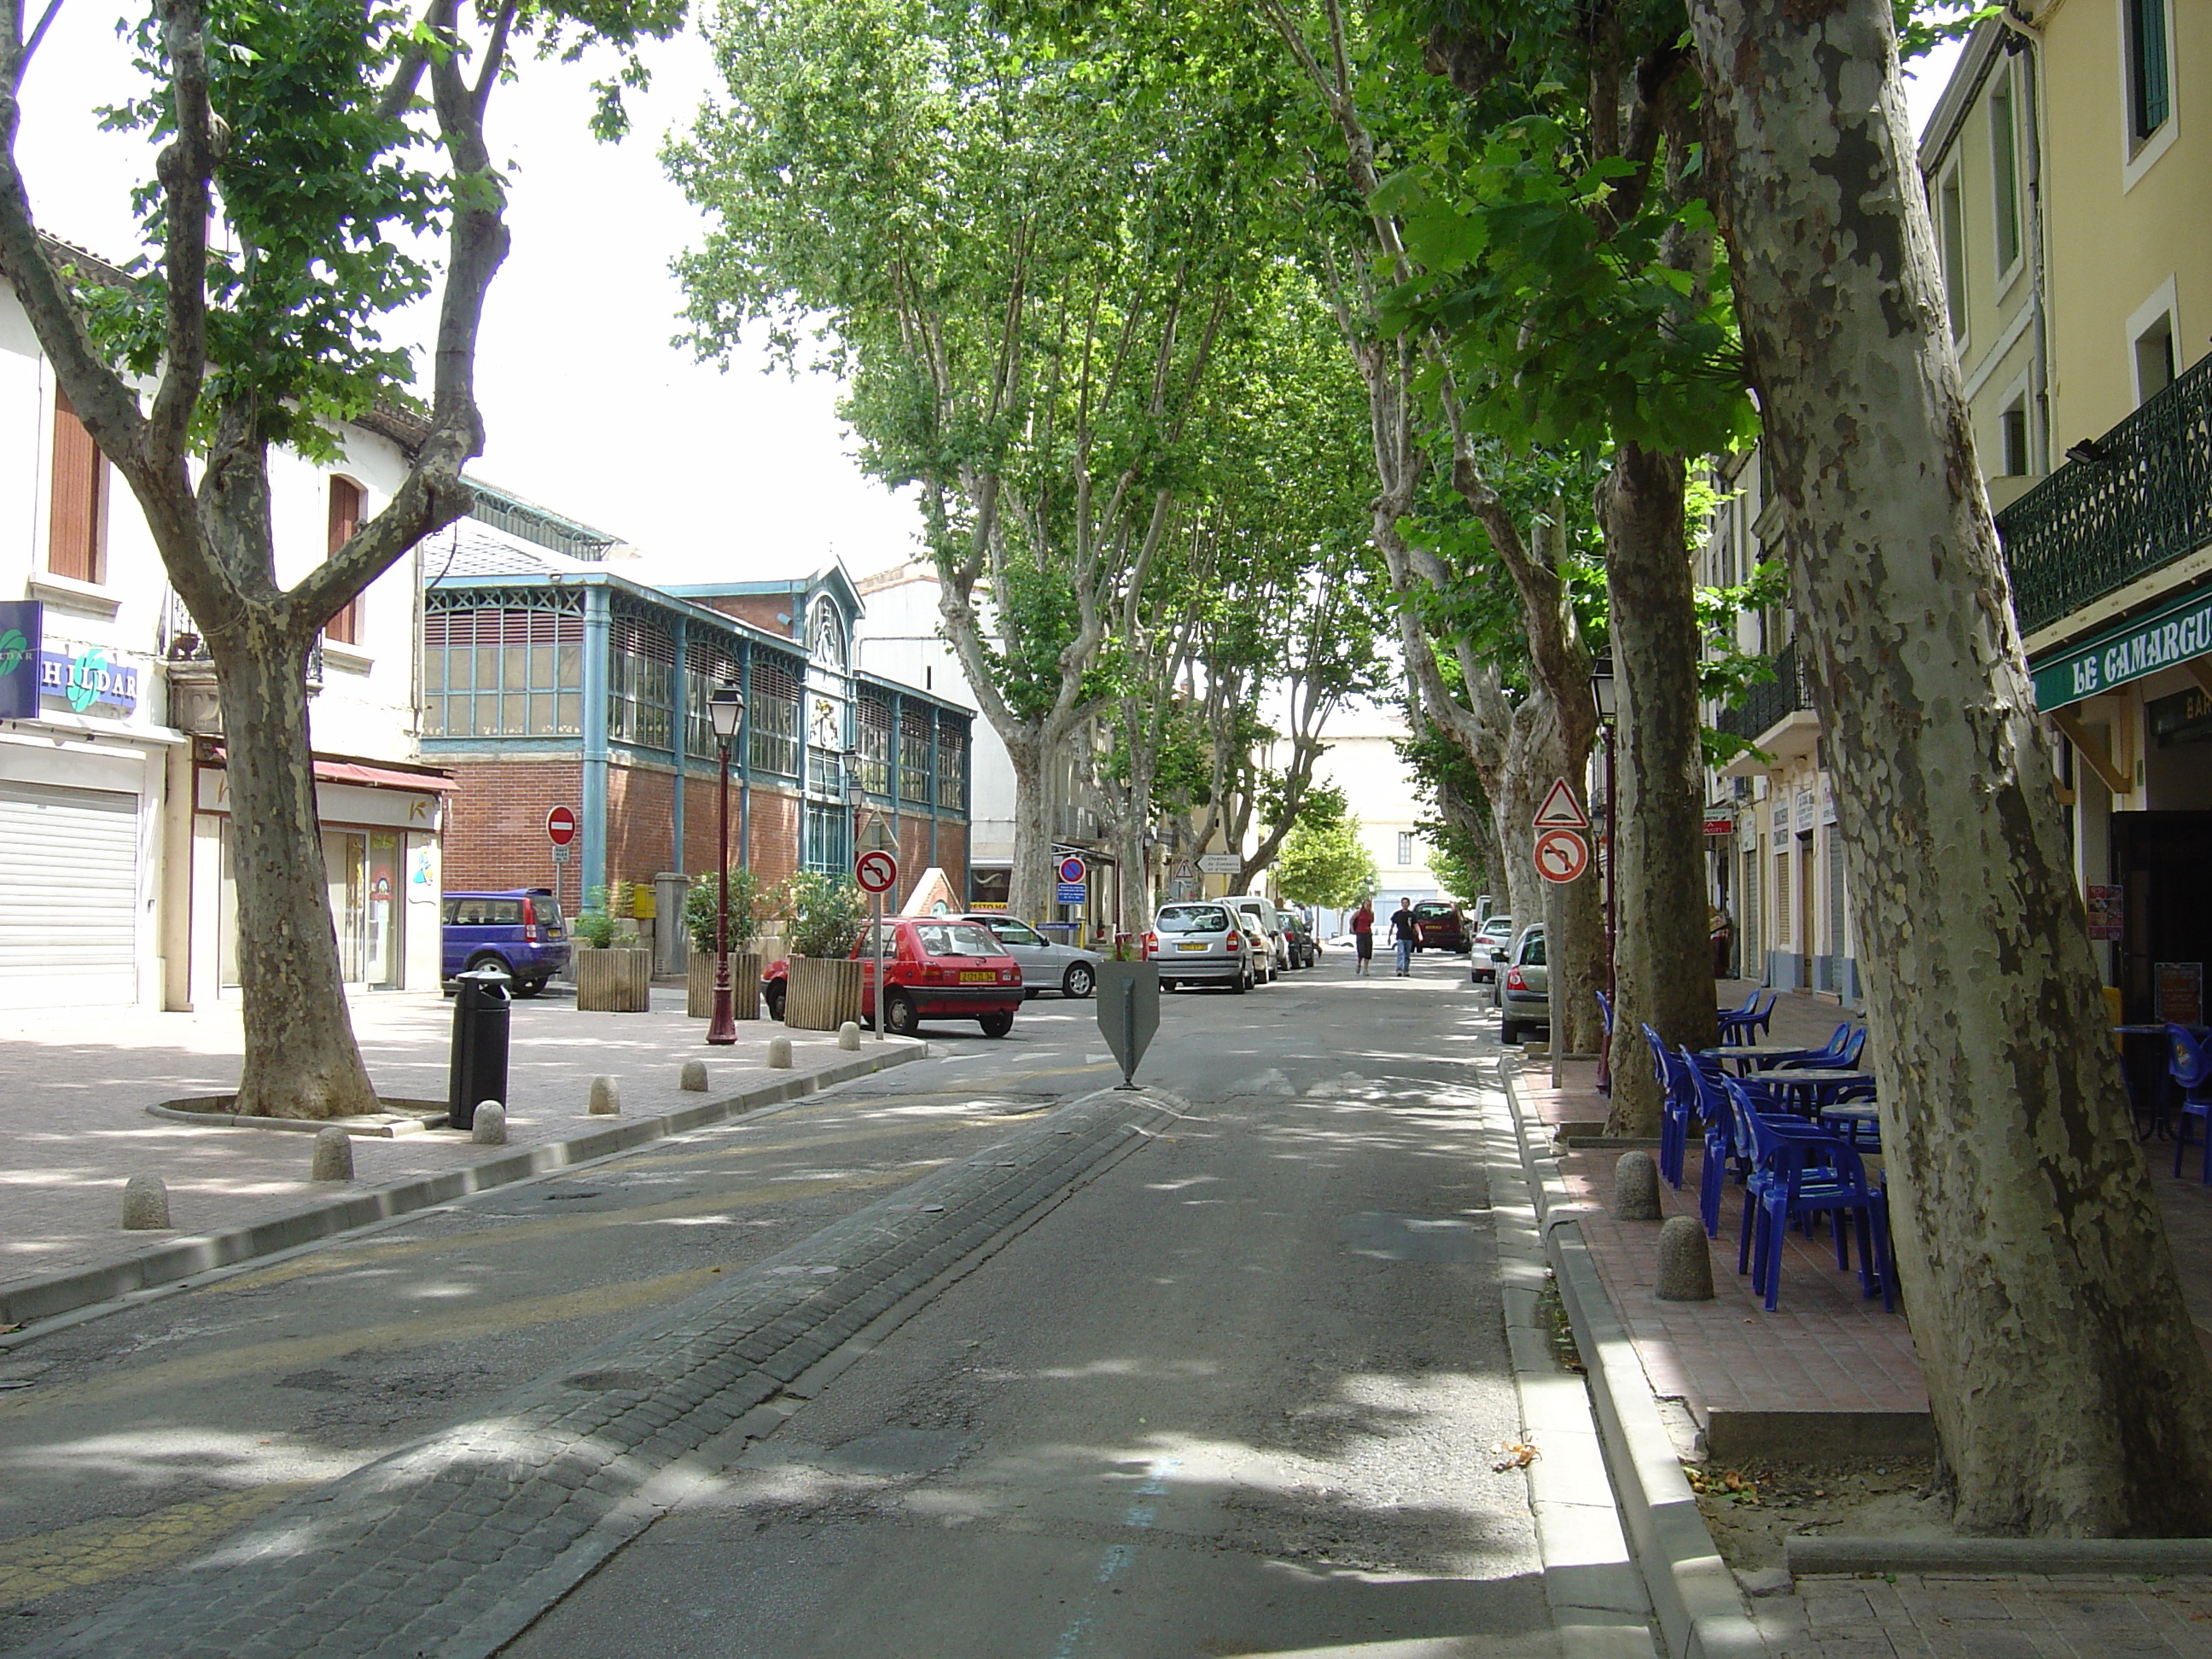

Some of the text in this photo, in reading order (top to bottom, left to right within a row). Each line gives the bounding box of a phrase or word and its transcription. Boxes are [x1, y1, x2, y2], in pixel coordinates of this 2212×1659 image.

[43, 661, 137, 698] HILDAR
[2071, 655, 2098, 696] LE
[2104, 606, 2212, 683] CAMARGU
